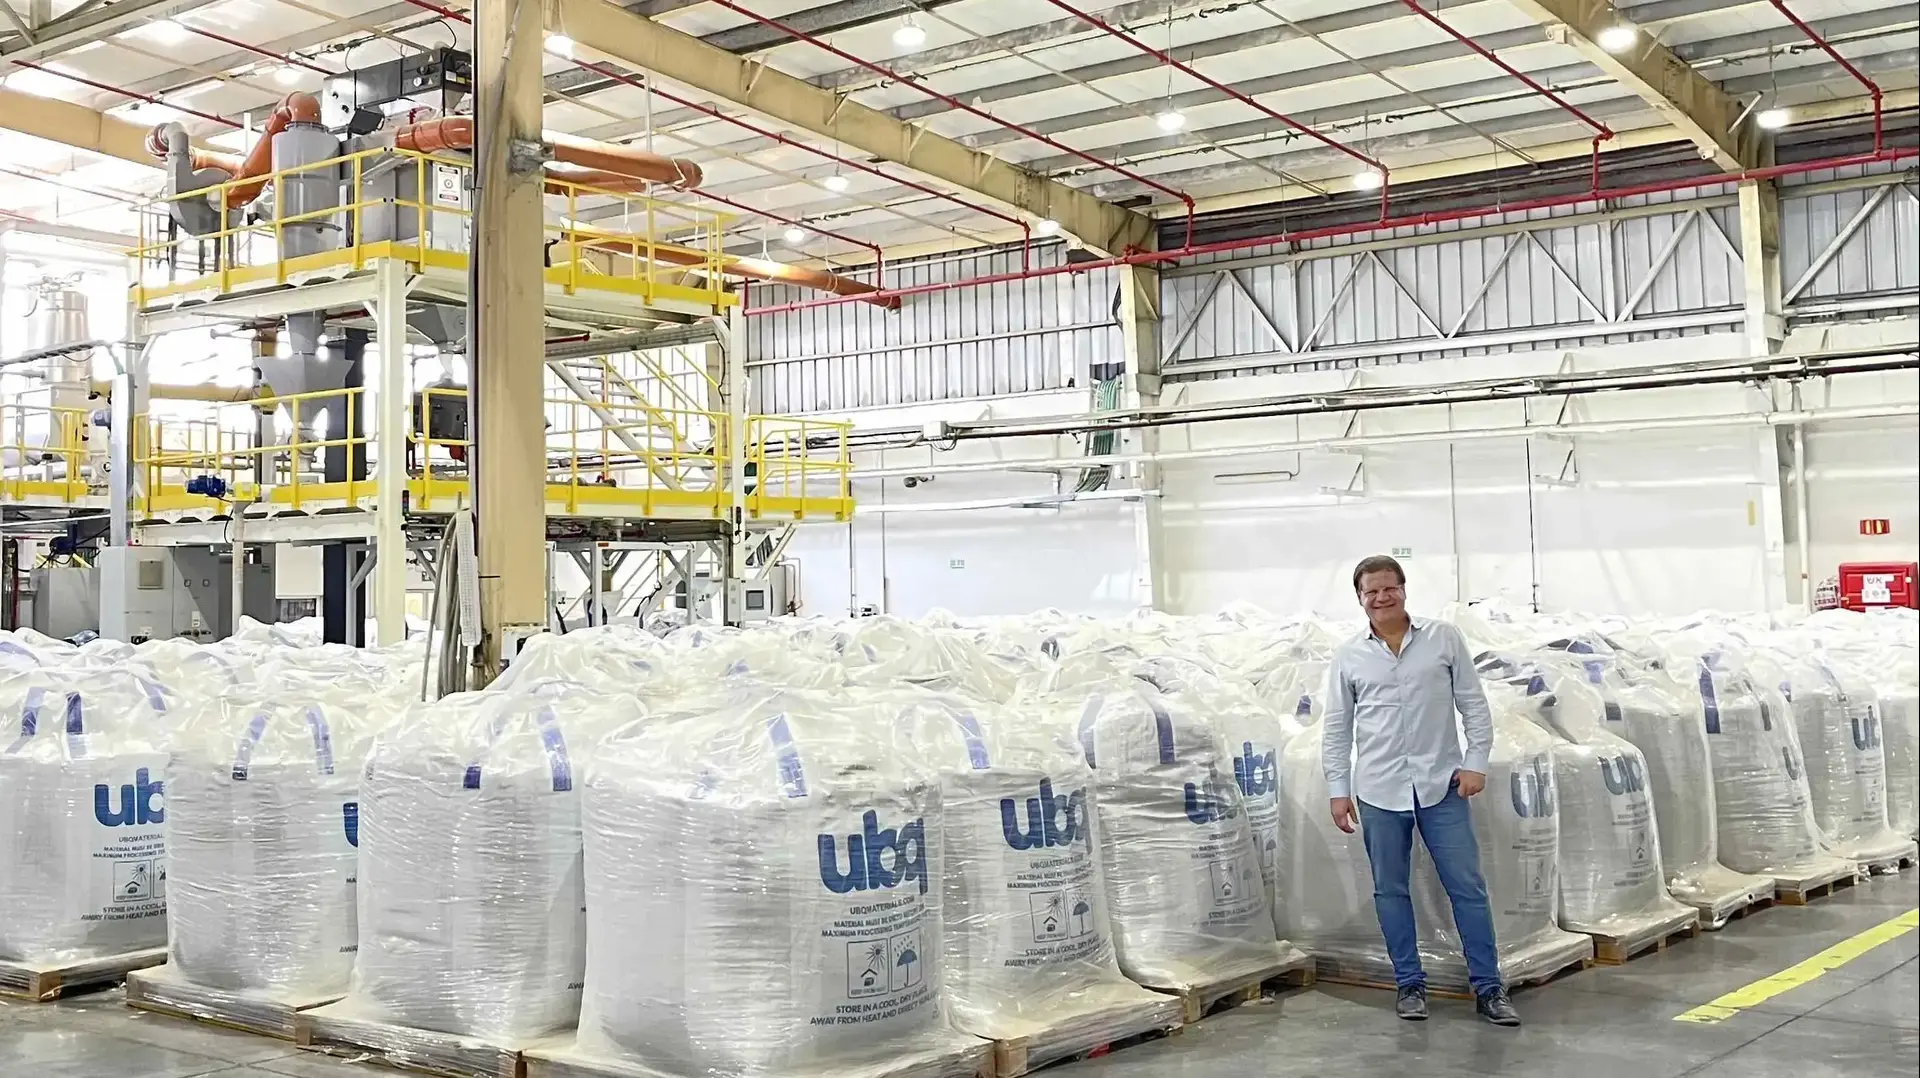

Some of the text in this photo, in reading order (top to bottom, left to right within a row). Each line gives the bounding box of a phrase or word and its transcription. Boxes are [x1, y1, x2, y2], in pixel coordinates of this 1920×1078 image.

[1000, 776, 1093, 856] ubq
[817, 808, 929, 896] ubq
[125, 911, 143, 919] HEAT
[849, 896, 915, 915] UBQMATERIALS.COM
[821, 929, 857, 937] MAXIMUM
[834, 919, 864, 928] MATERIAL
[810, 1016, 836, 1026] AWAY
[837, 1013, 861, 1025] FROM
[861, 1011, 881, 1022] HEAT
[882, 1008, 897, 1019] AND
[897, 1000, 918, 1015] DIRECT
[836, 1004, 861, 1014] STORE
[862, 1003, 872, 1013] IN
[872, 1002, 878, 1012] A
[899, 994, 912, 1004] DRY
